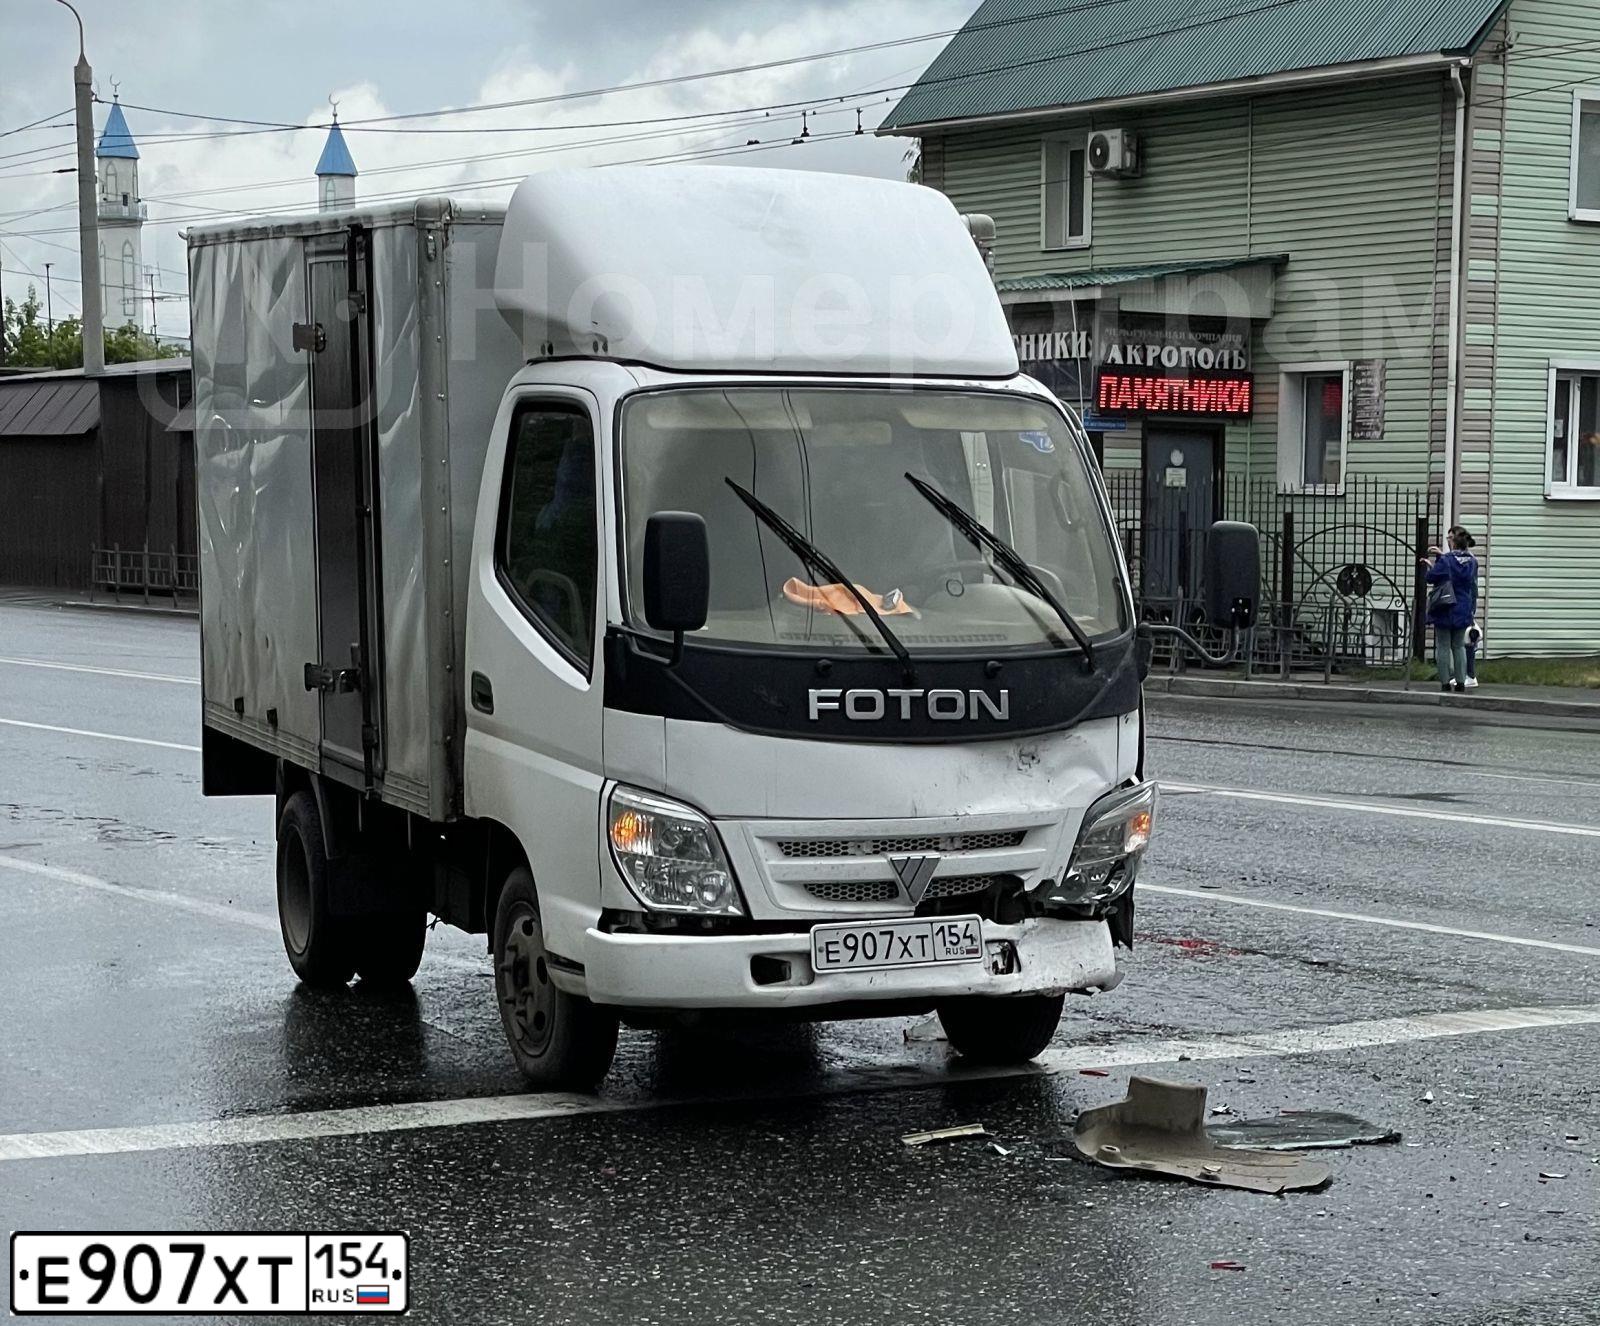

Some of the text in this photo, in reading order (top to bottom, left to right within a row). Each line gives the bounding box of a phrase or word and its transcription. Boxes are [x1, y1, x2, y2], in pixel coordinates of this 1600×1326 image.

[1105, 343, 1247, 371] АКРОПОЛЬ
[1100, 375, 1250, 413] ПАМЯТНИКИ
[808, 688, 1010, 721] FOTON
[934, 922, 975, 948] 154
[945, 946, 966, 956] RUS
